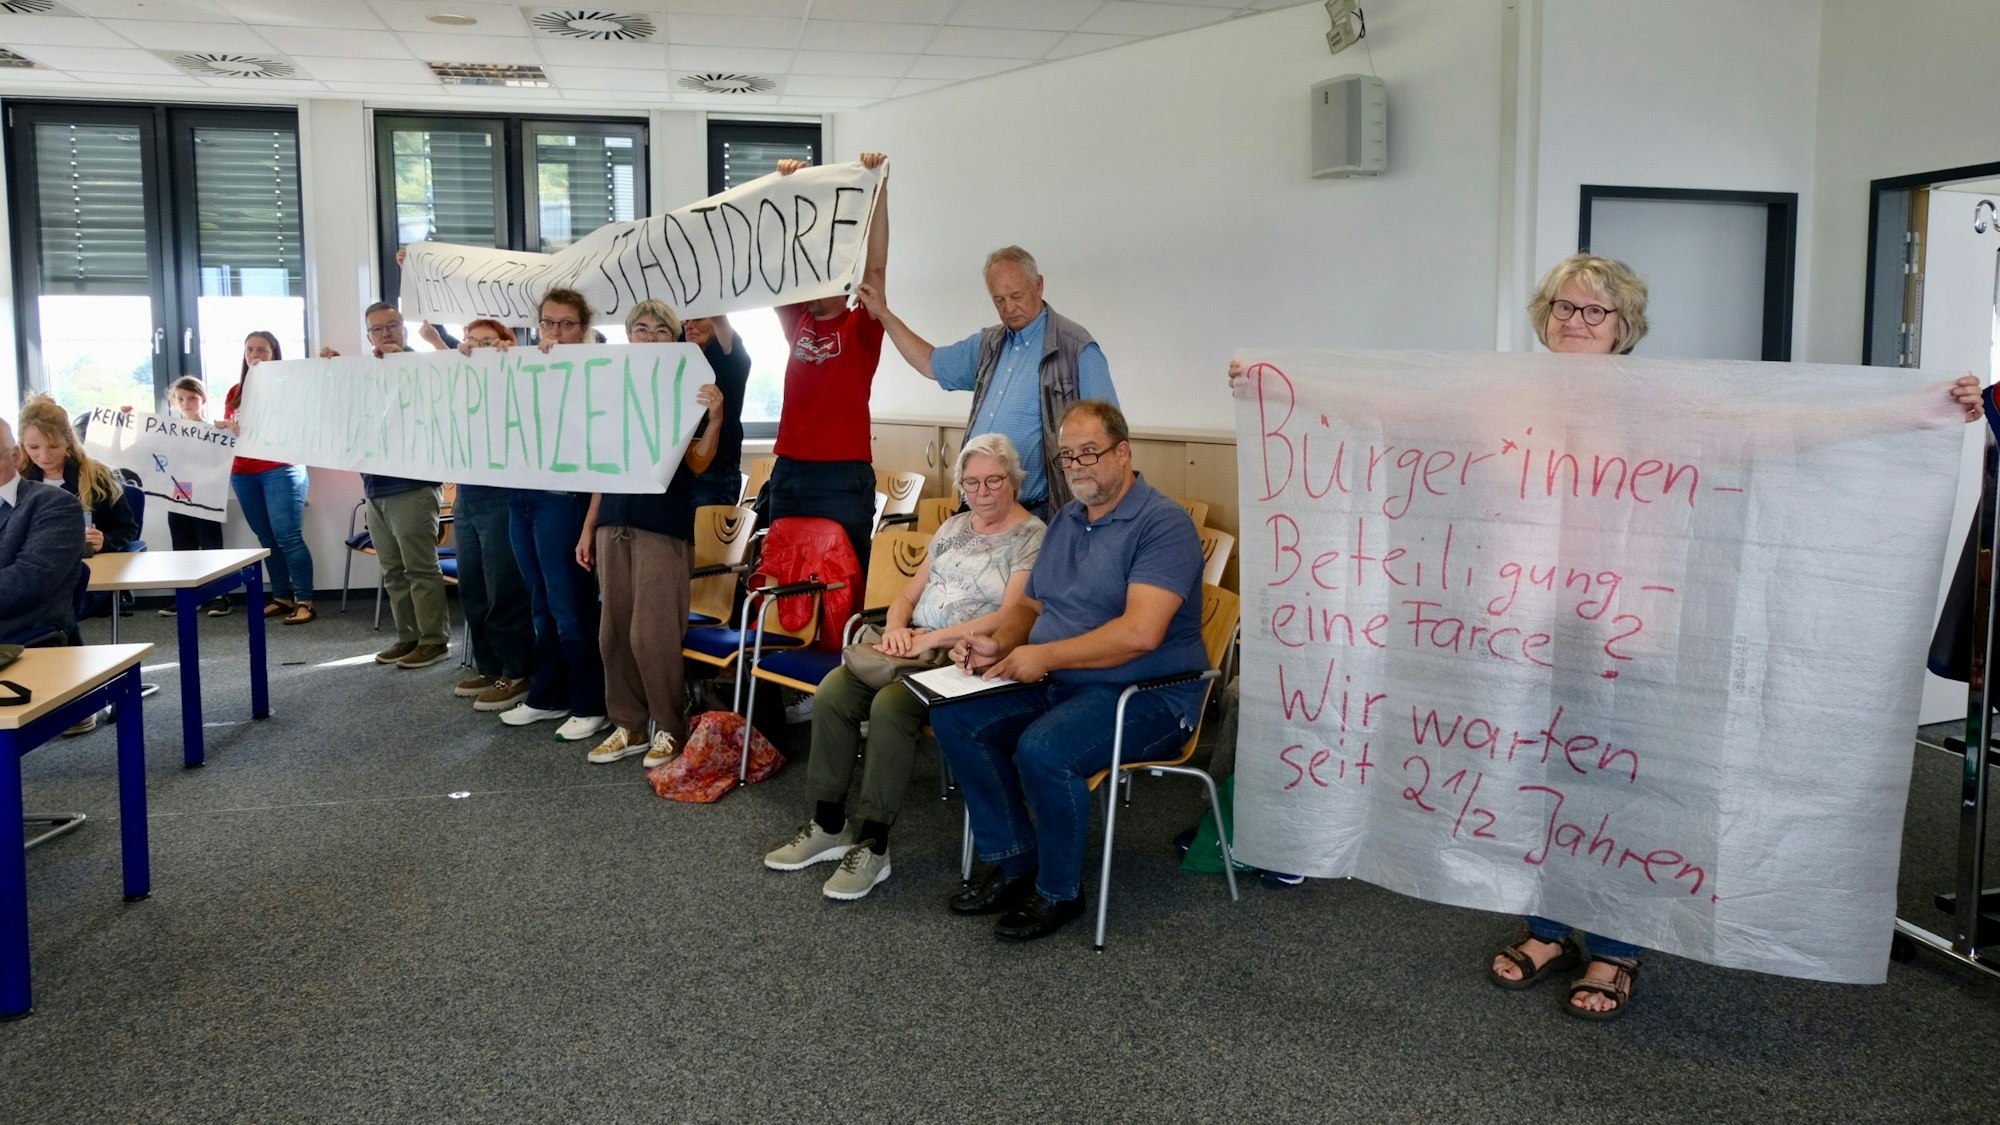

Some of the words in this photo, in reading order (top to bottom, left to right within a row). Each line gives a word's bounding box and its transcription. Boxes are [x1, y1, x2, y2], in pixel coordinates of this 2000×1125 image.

[409, 251, 465, 315] MEHR
[599, 186, 878, 316] STADTDORF!
[92, 406, 135, 430] KEINE
[145, 417, 236, 449] PARKPLÄTZE
[399, 354, 687, 475] PARKPLÄTZEN!
[1271, 591, 1390, 649] eine
[1278, 657, 1388, 732] Wir
[1412, 705, 1639, 783] warten
[1279, 738, 1375, 790] seit
[1518, 785, 1719, 904] Jahren.
